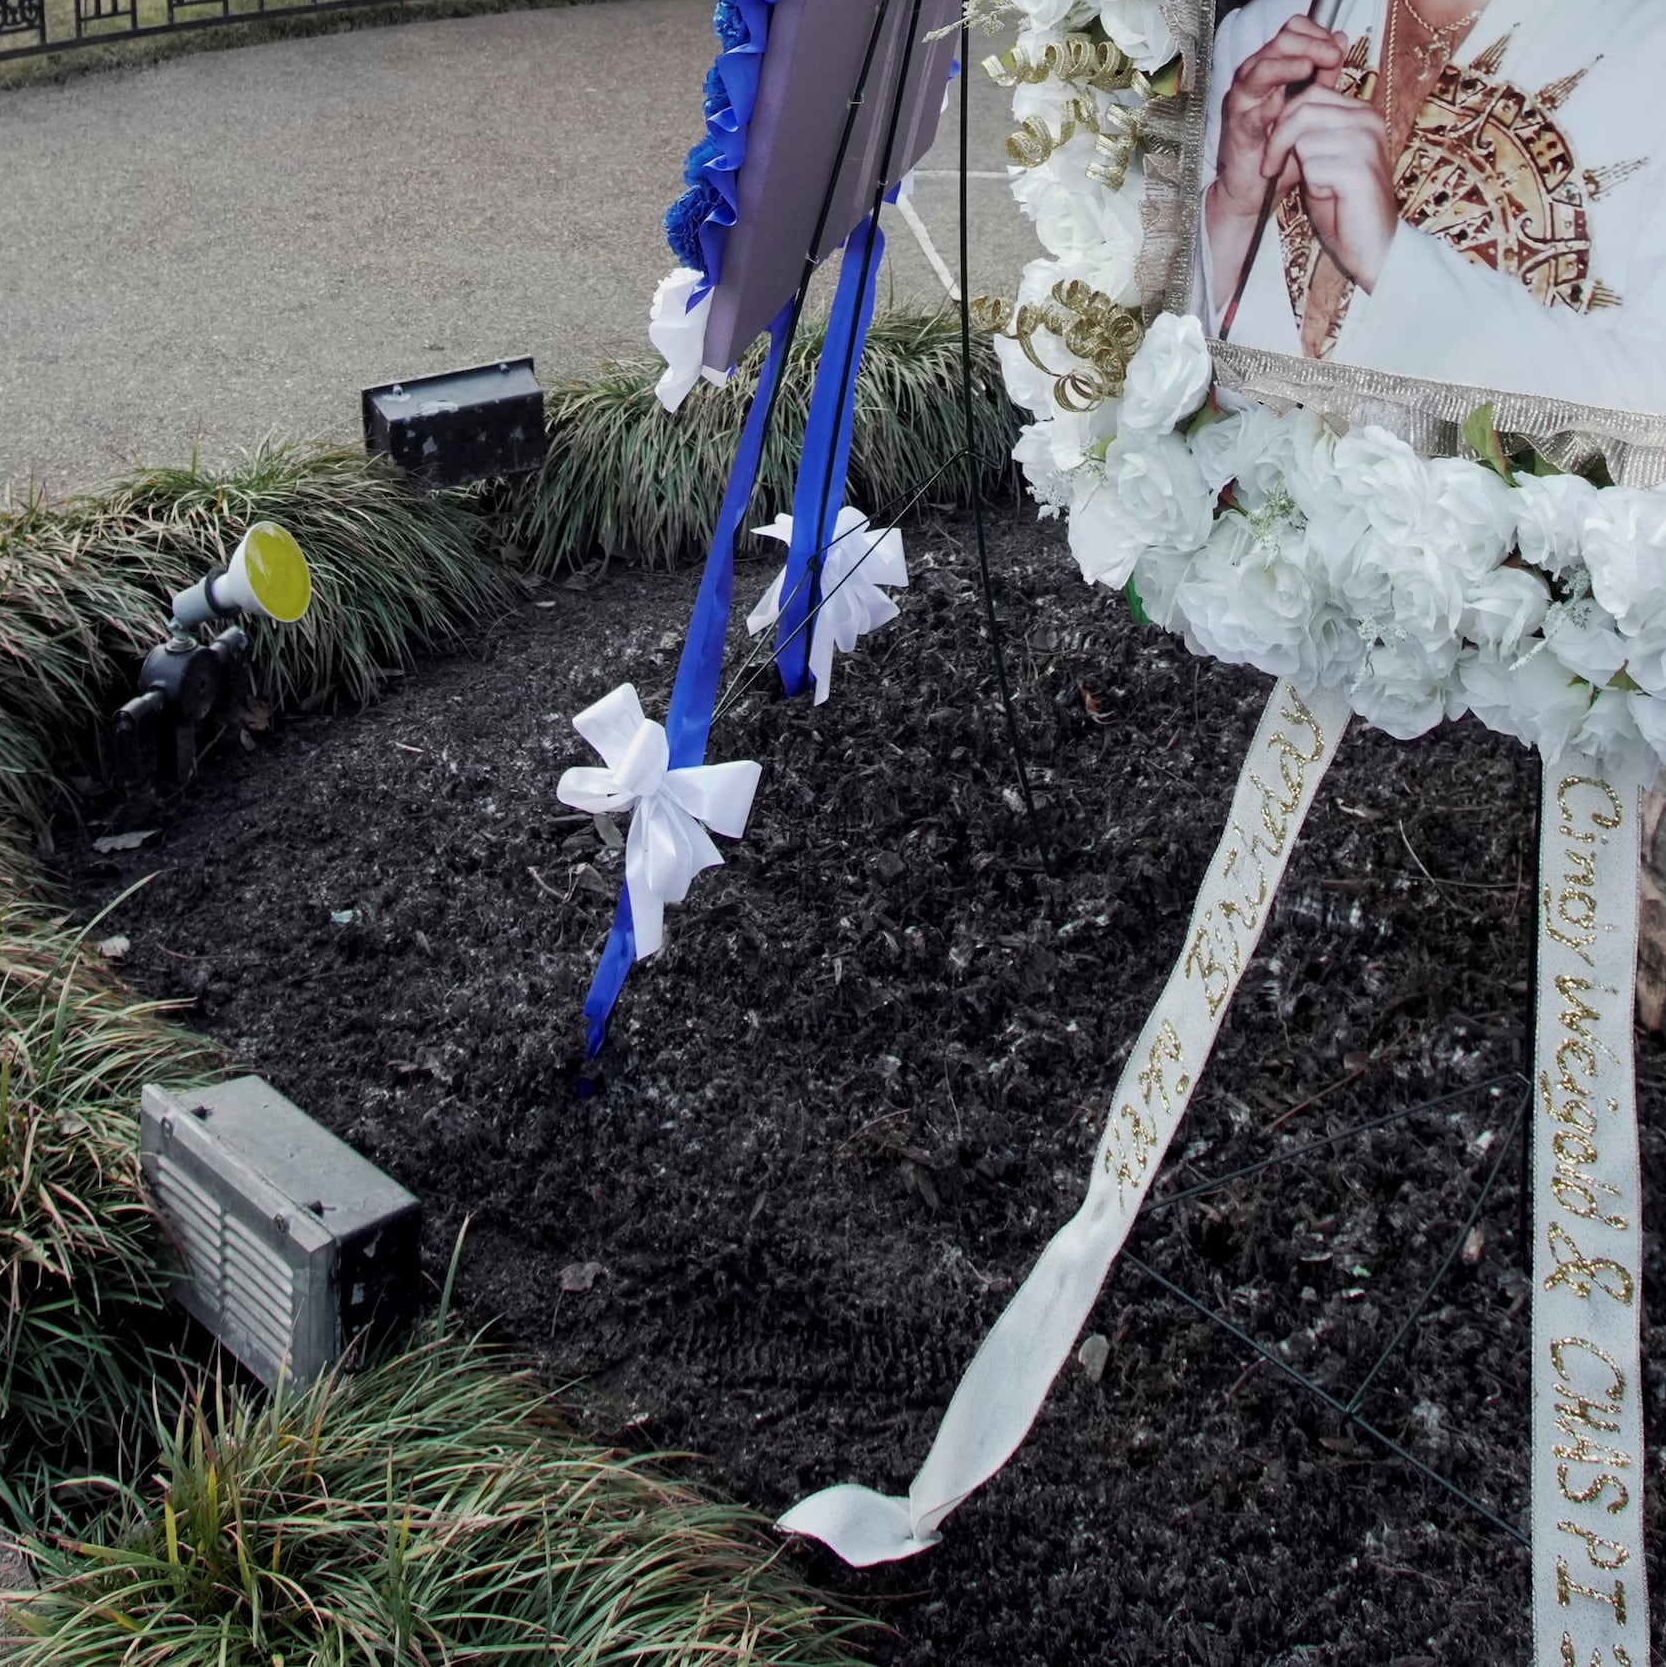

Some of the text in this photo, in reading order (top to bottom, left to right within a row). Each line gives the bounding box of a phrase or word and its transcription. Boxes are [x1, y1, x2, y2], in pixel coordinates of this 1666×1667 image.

[1104, 683, 1325, 1215] Happy Birthday
[1543, 774, 1624, 968] Cindy
[1539, 974, 1629, 1231] Weigold
[1543, 1221, 1633, 1308] &
